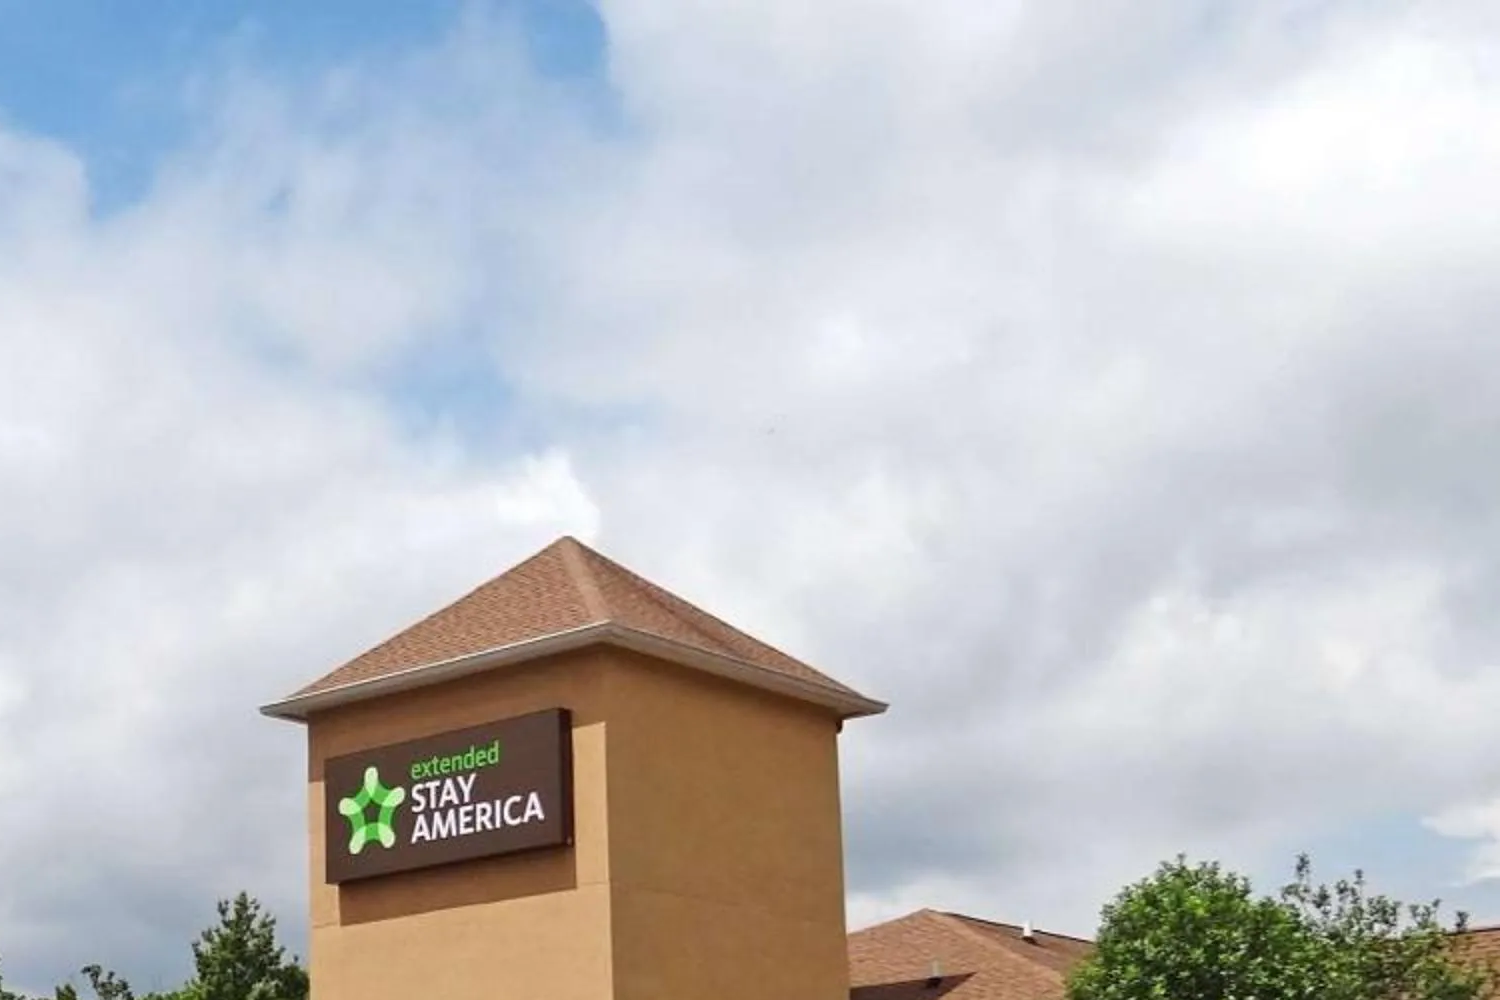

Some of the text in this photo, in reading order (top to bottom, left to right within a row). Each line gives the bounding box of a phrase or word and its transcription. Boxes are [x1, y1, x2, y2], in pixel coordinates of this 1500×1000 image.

[411, 740, 499, 779] extended
[411, 774, 476, 812] STAY
[410, 792, 544, 843] AMERICA
